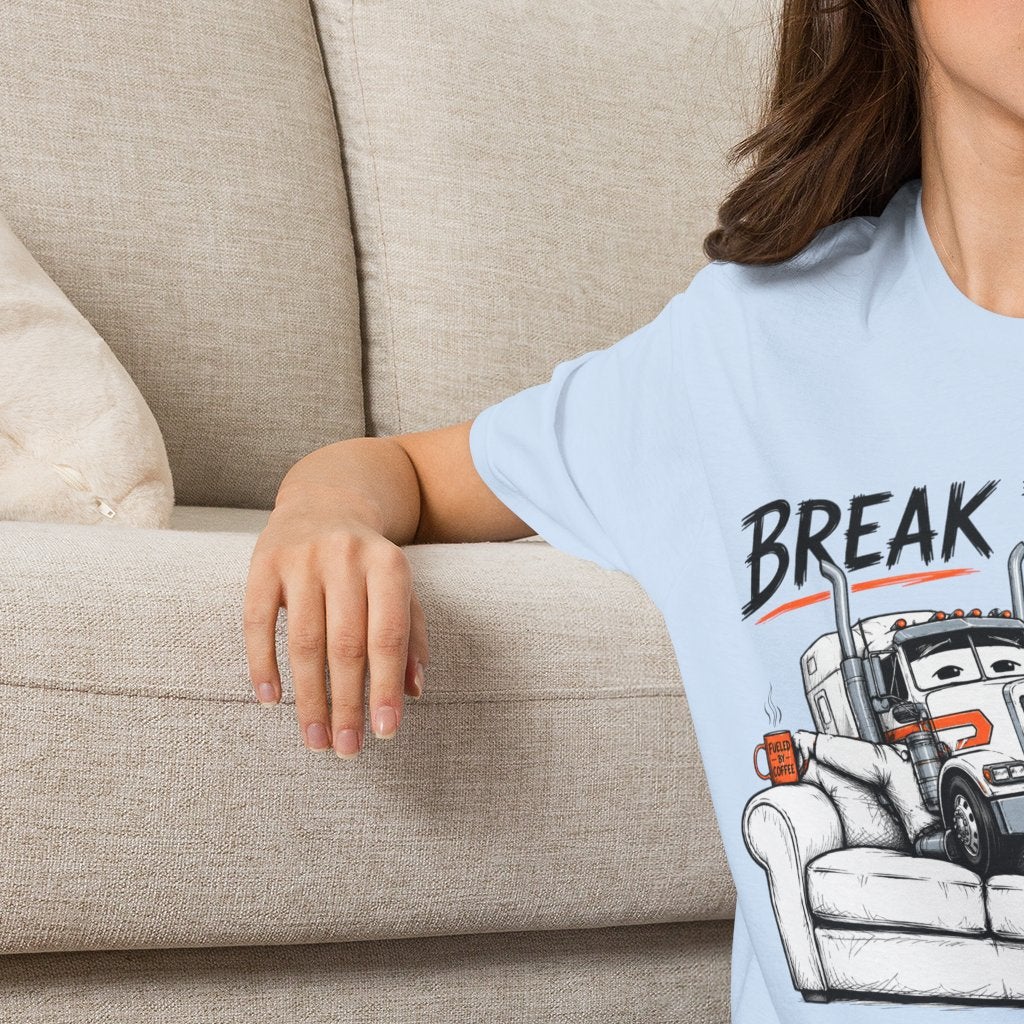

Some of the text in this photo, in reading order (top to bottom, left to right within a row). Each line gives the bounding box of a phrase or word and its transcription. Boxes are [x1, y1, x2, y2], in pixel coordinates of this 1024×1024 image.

[741, 479, 1001, 621] BREAK
[768, 740, 790, 754] FUELED
[773, 764, 795, 777] COFFEE
